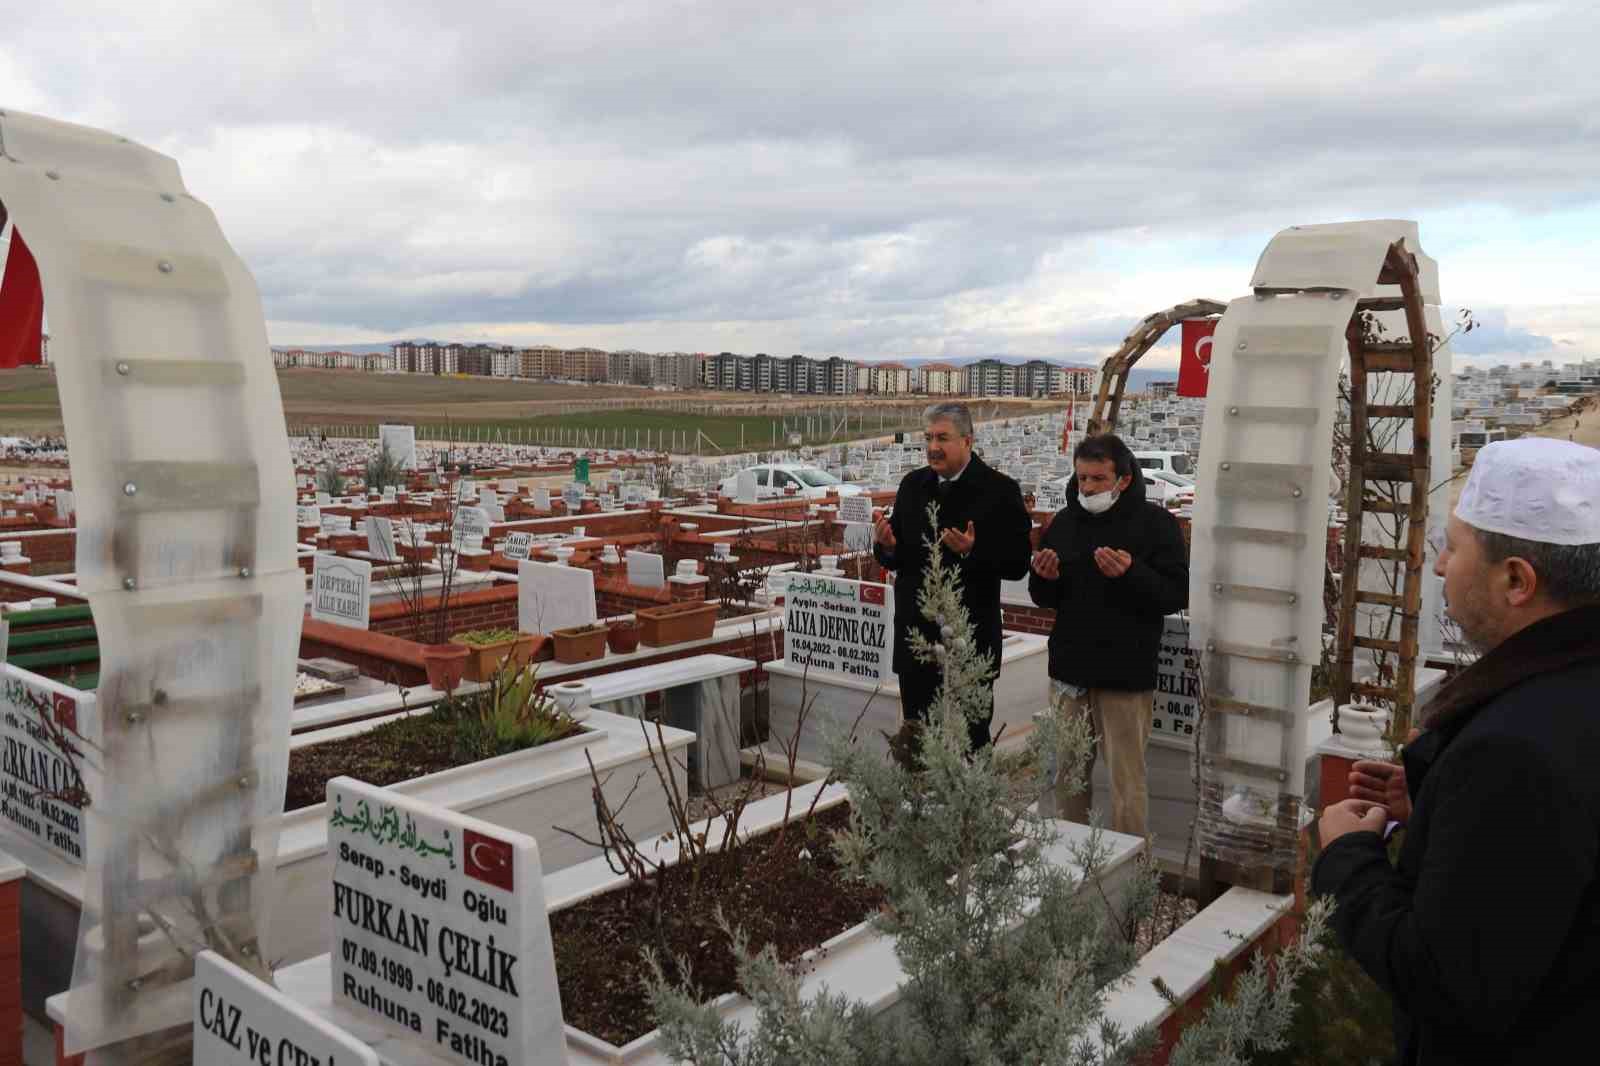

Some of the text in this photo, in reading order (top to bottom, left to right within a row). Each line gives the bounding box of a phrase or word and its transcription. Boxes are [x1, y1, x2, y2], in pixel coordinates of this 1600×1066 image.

[787, 609, 886, 649] ALYA DEFNE CAZ
[842, 661, 879, 679] Fatiha
[47, 823, 81, 858] Fatiha
[340, 841, 385, 879] Serap
[400, 864, 447, 901] Seydi
[463, 889, 507, 926] Oğlu
[333, 880, 519, 998] FURKAN ÇELİK
[342, 937, 414, 993] 07.09.1999
[427, 976, 509, 1039] 06.02.2023
[343, 971, 423, 1034] Ruhuna
[200, 987, 242, 1051] CAZ
[247, 1026, 271, 1066] ve
